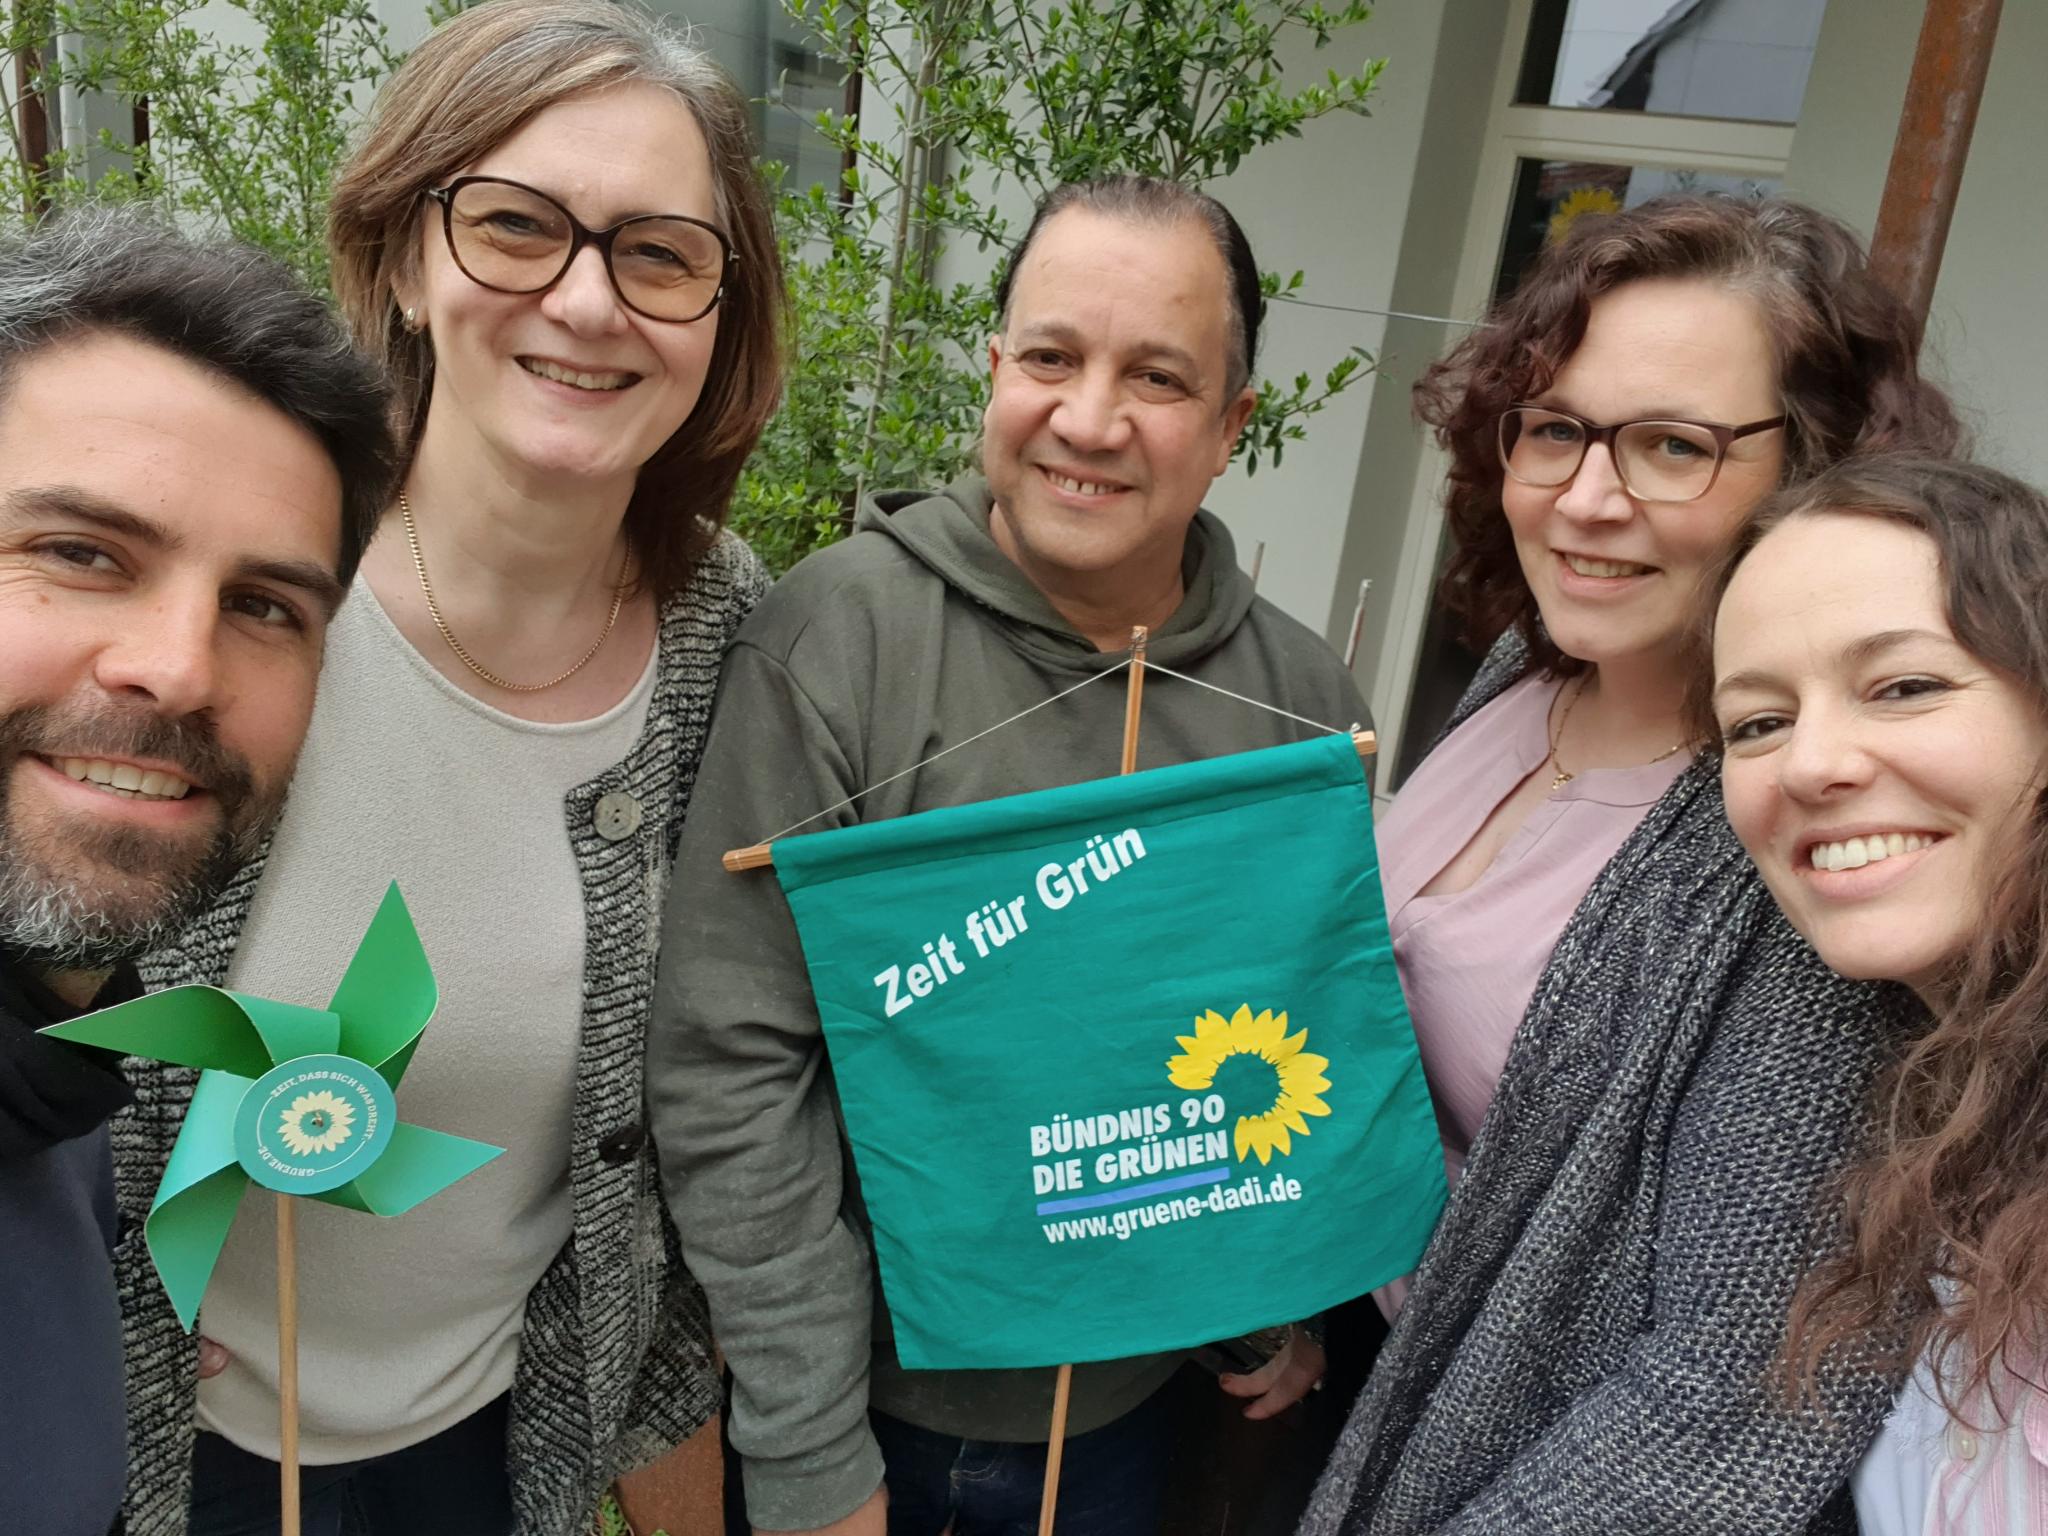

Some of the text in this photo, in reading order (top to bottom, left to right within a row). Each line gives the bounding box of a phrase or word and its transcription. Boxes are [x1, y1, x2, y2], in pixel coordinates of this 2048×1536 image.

[873, 827, 1148, 1018] Zeit für Grün
[298, 1071, 329, 1082] DASS
[329, 1072, 358, 1086] SICH
[356, 1085, 375, 1104] WAS
[1029, 1094, 1226, 1158] BÜNDNIS 90
[258, 1146, 315, 1176] GRUENE.DE
[1032, 1128, 1229, 1196] DIE GRÜNEN
[1041, 1174, 1303, 1244] www.gruene-dadi.de
